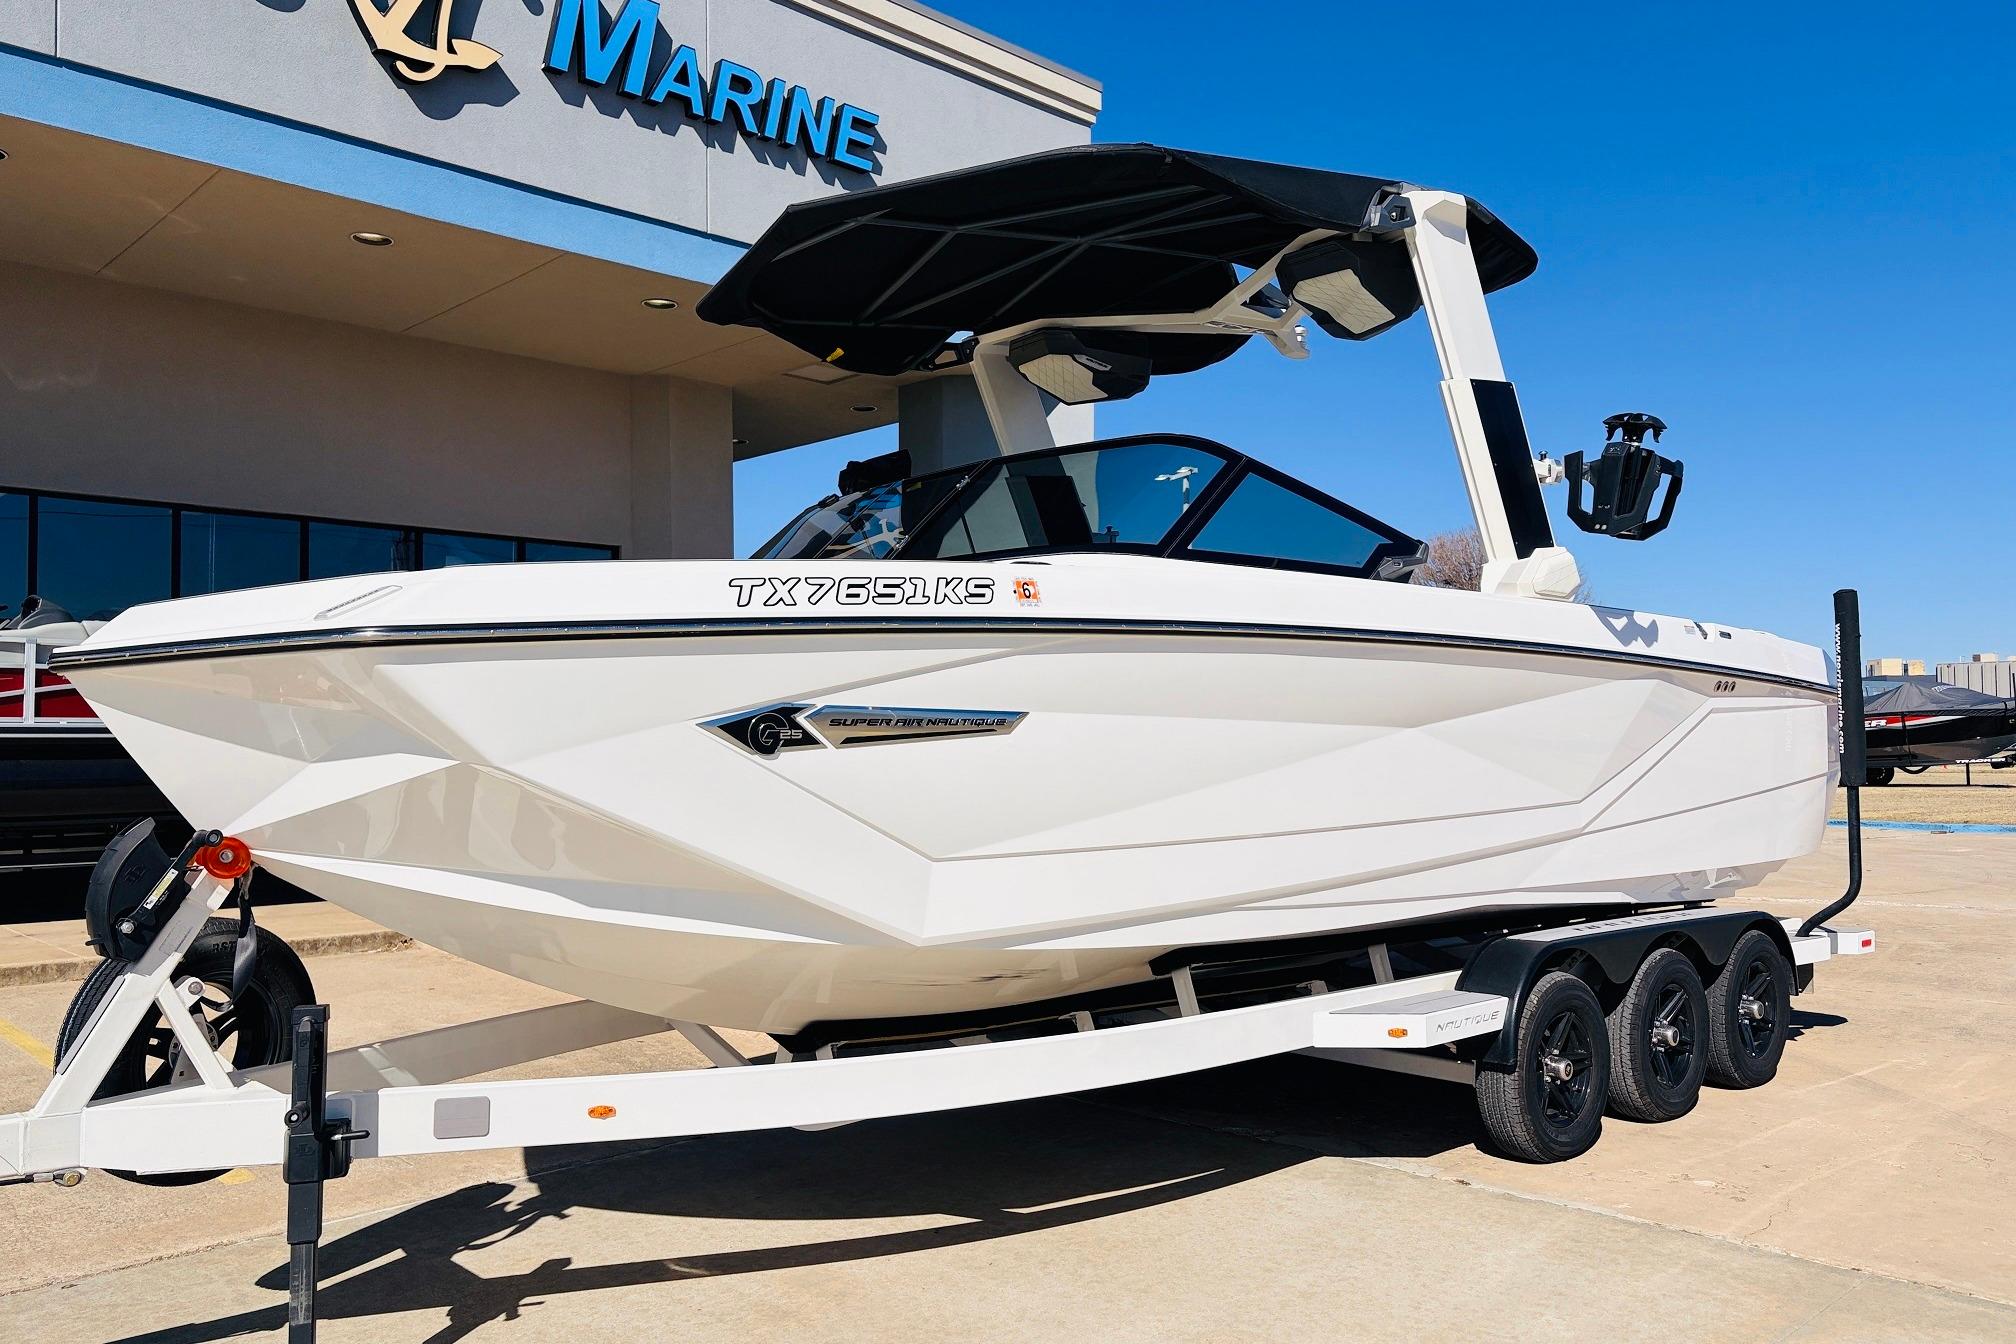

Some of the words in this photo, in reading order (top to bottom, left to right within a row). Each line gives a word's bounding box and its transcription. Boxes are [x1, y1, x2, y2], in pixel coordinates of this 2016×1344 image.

[542, 0, 880, 174] MARINE
[1021, 581, 1032, 599] 6
[828, 718, 893, 727] SUPER
[894, 718, 924, 727] AIR
[925, 718, 1008, 728] NAUTIQUE
[1436, 1010, 1501, 1033] NAUTIQUE
